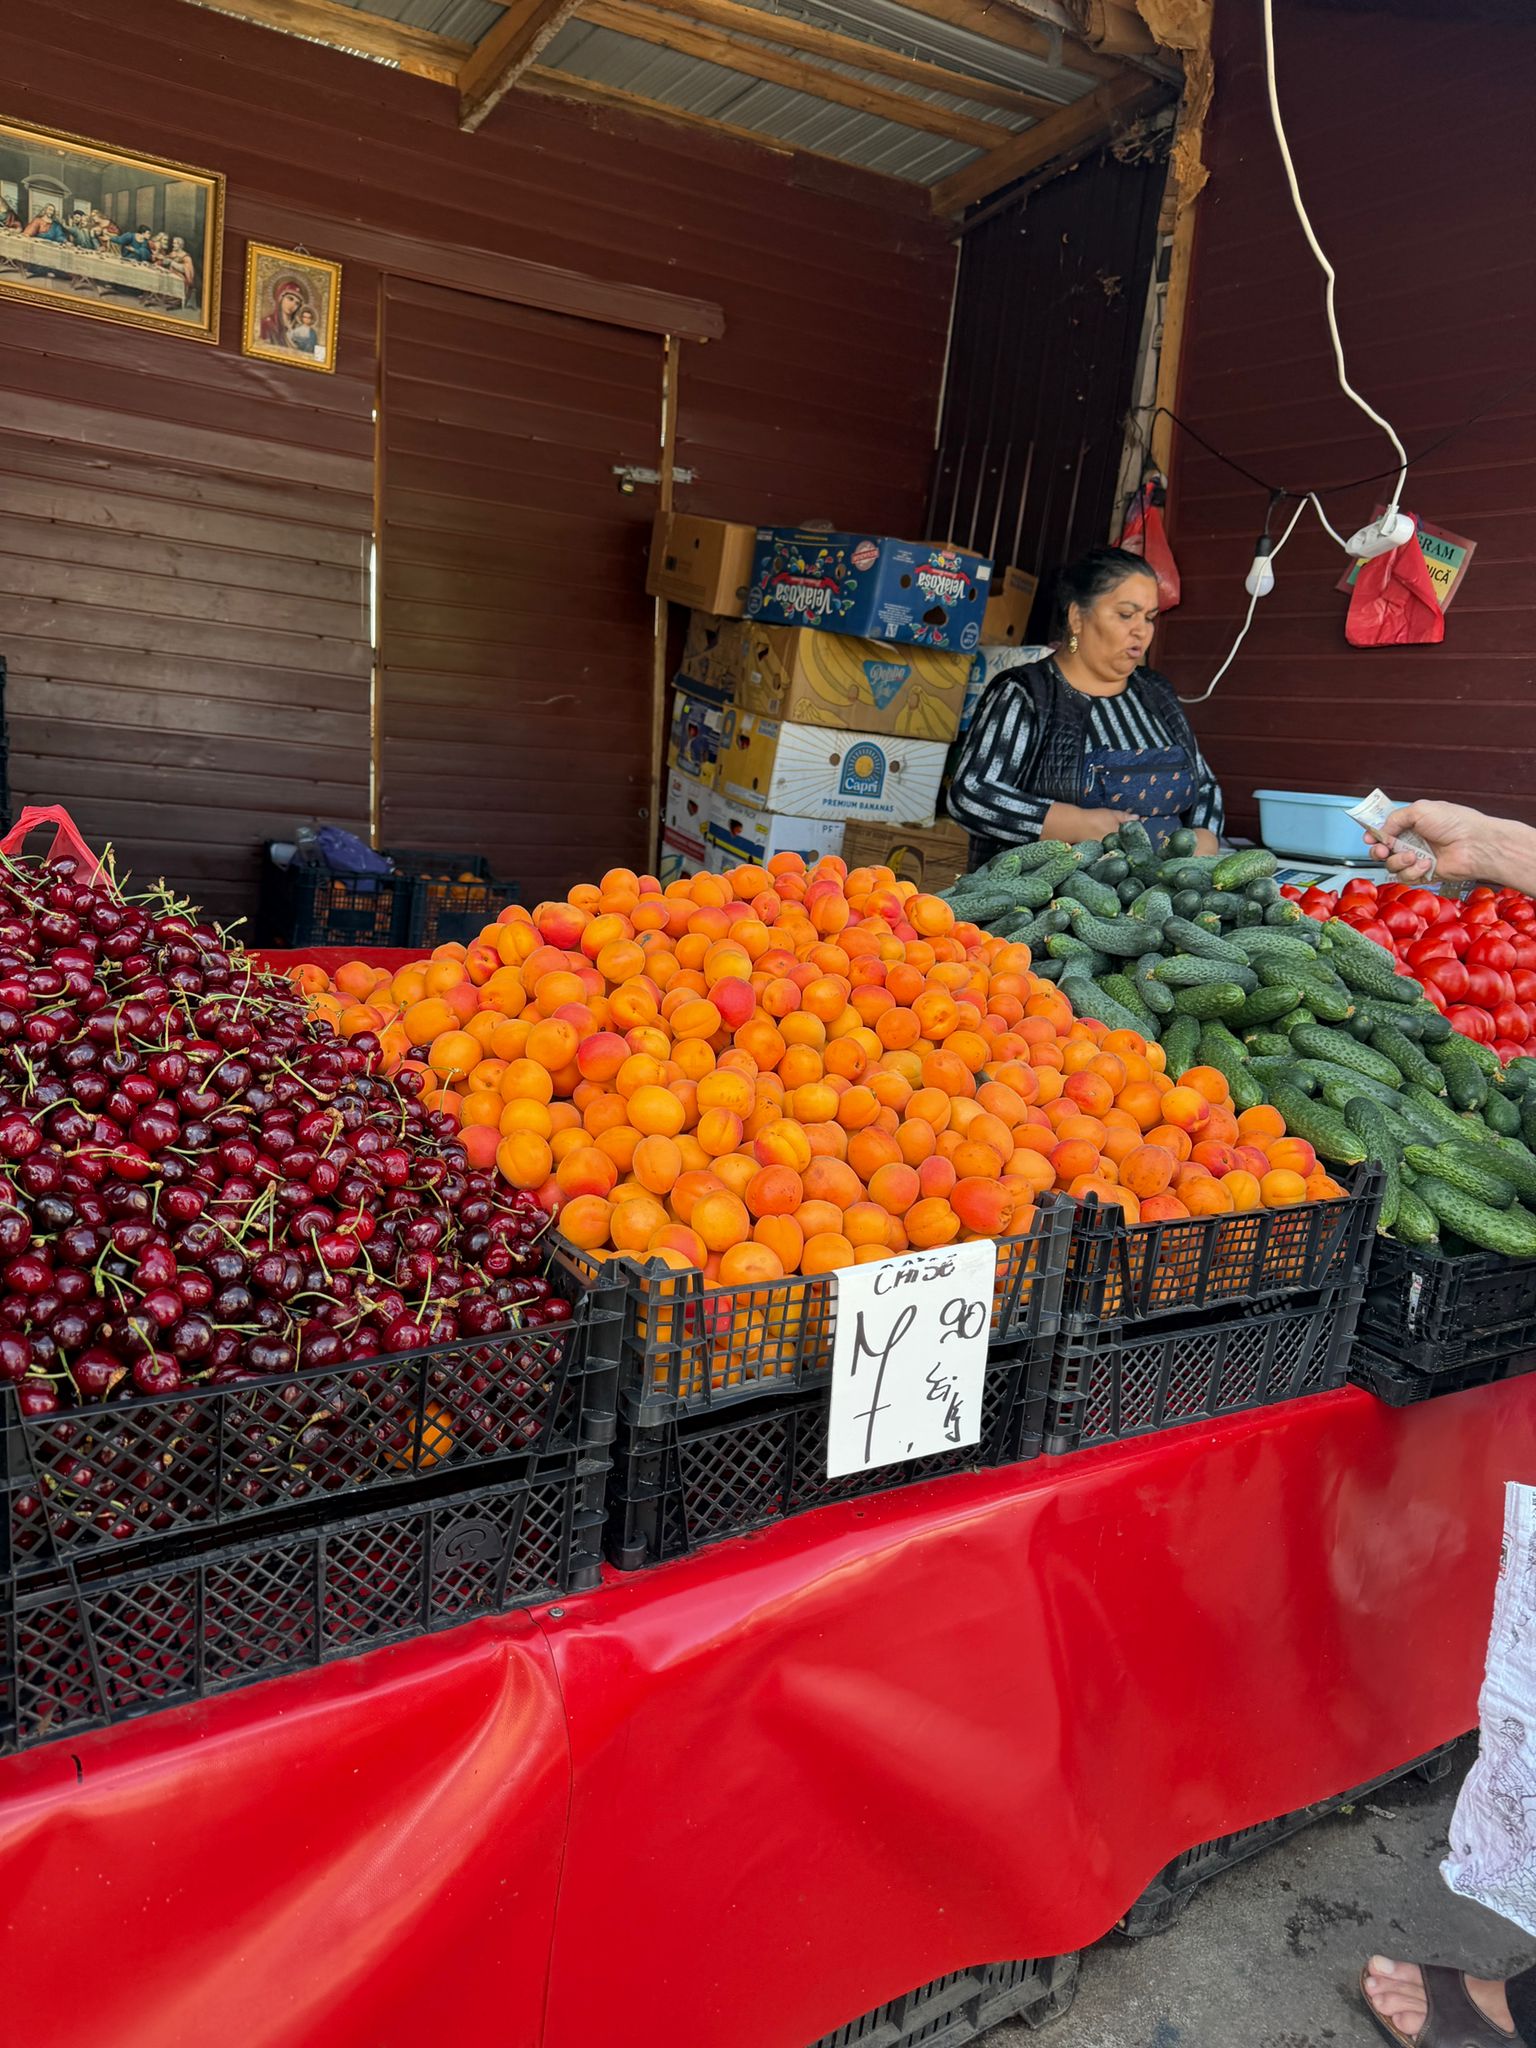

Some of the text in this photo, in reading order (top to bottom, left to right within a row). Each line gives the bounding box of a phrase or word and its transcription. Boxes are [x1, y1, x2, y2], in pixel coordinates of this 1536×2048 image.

[844, 777, 879, 795] Capri
[822, 798, 894, 813] PREMIUM BANANAS
